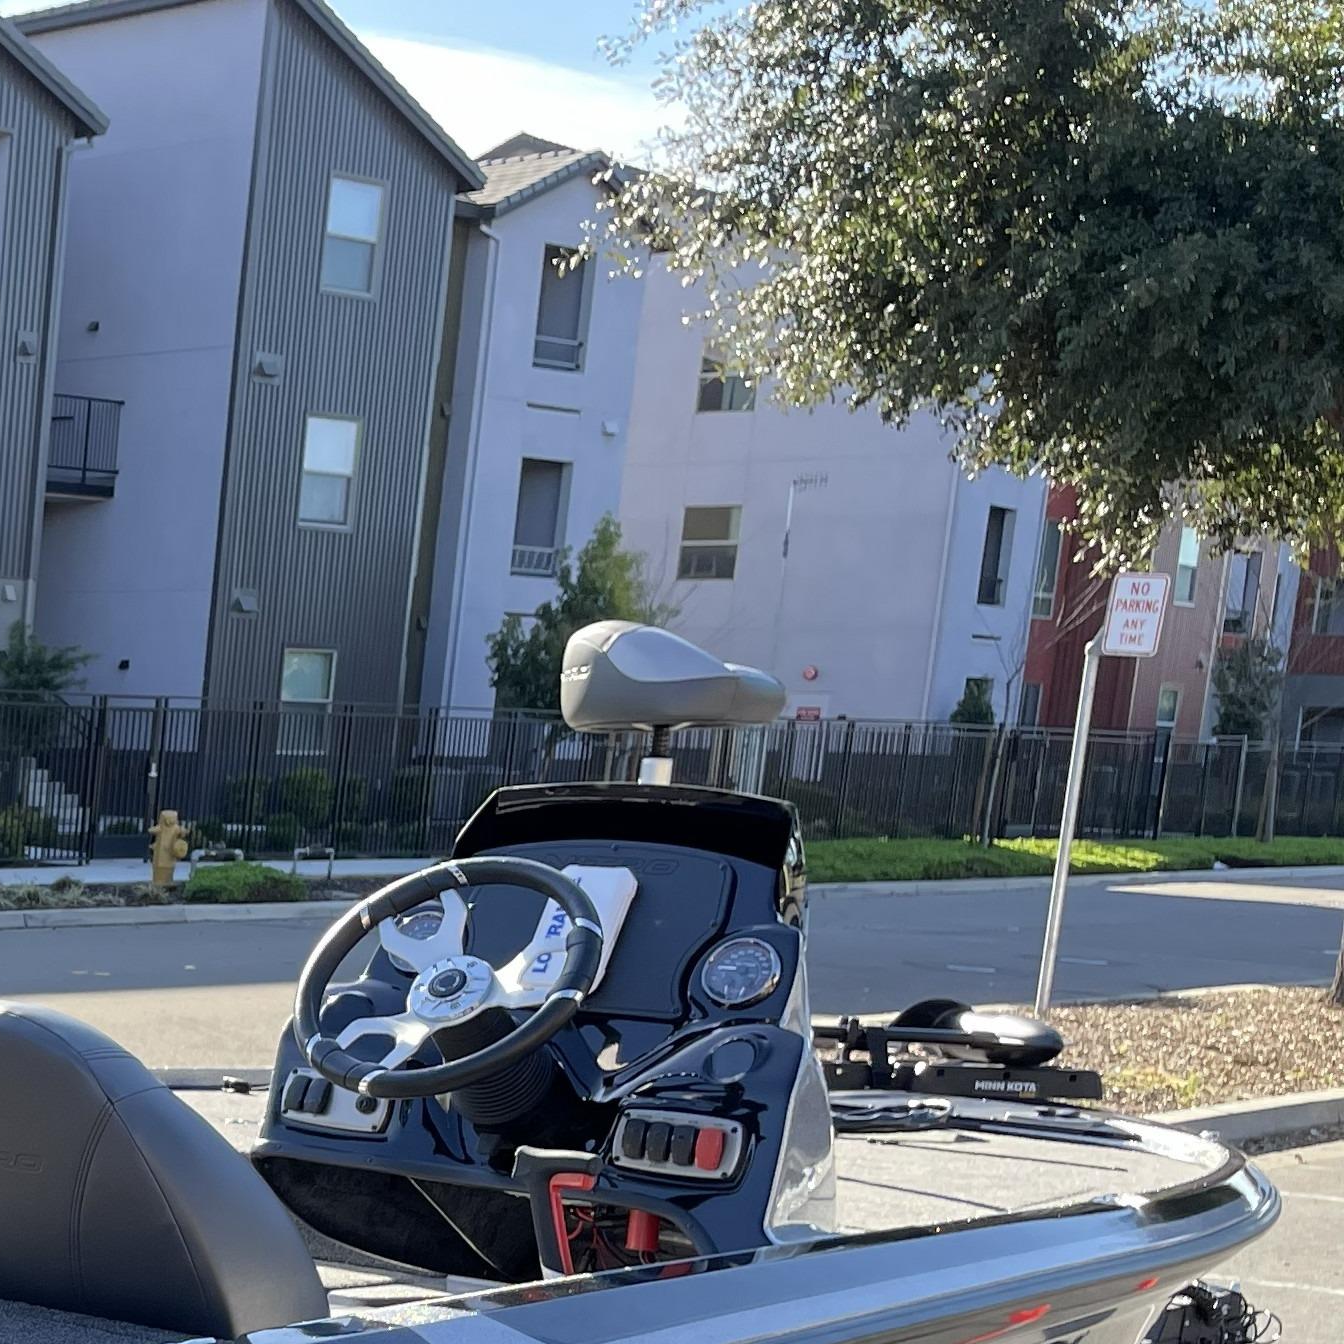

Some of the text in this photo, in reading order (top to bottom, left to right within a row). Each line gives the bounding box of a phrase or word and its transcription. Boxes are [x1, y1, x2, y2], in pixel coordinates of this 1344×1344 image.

[1130, 581, 1151, 596] NO
[1115, 599, 1159, 614] PARKING
[1122, 618, 1146, 630] ANY
[1119, 632, 1145, 646] TIME
[974, 1079, 1037, 1092] MINN KOTA
